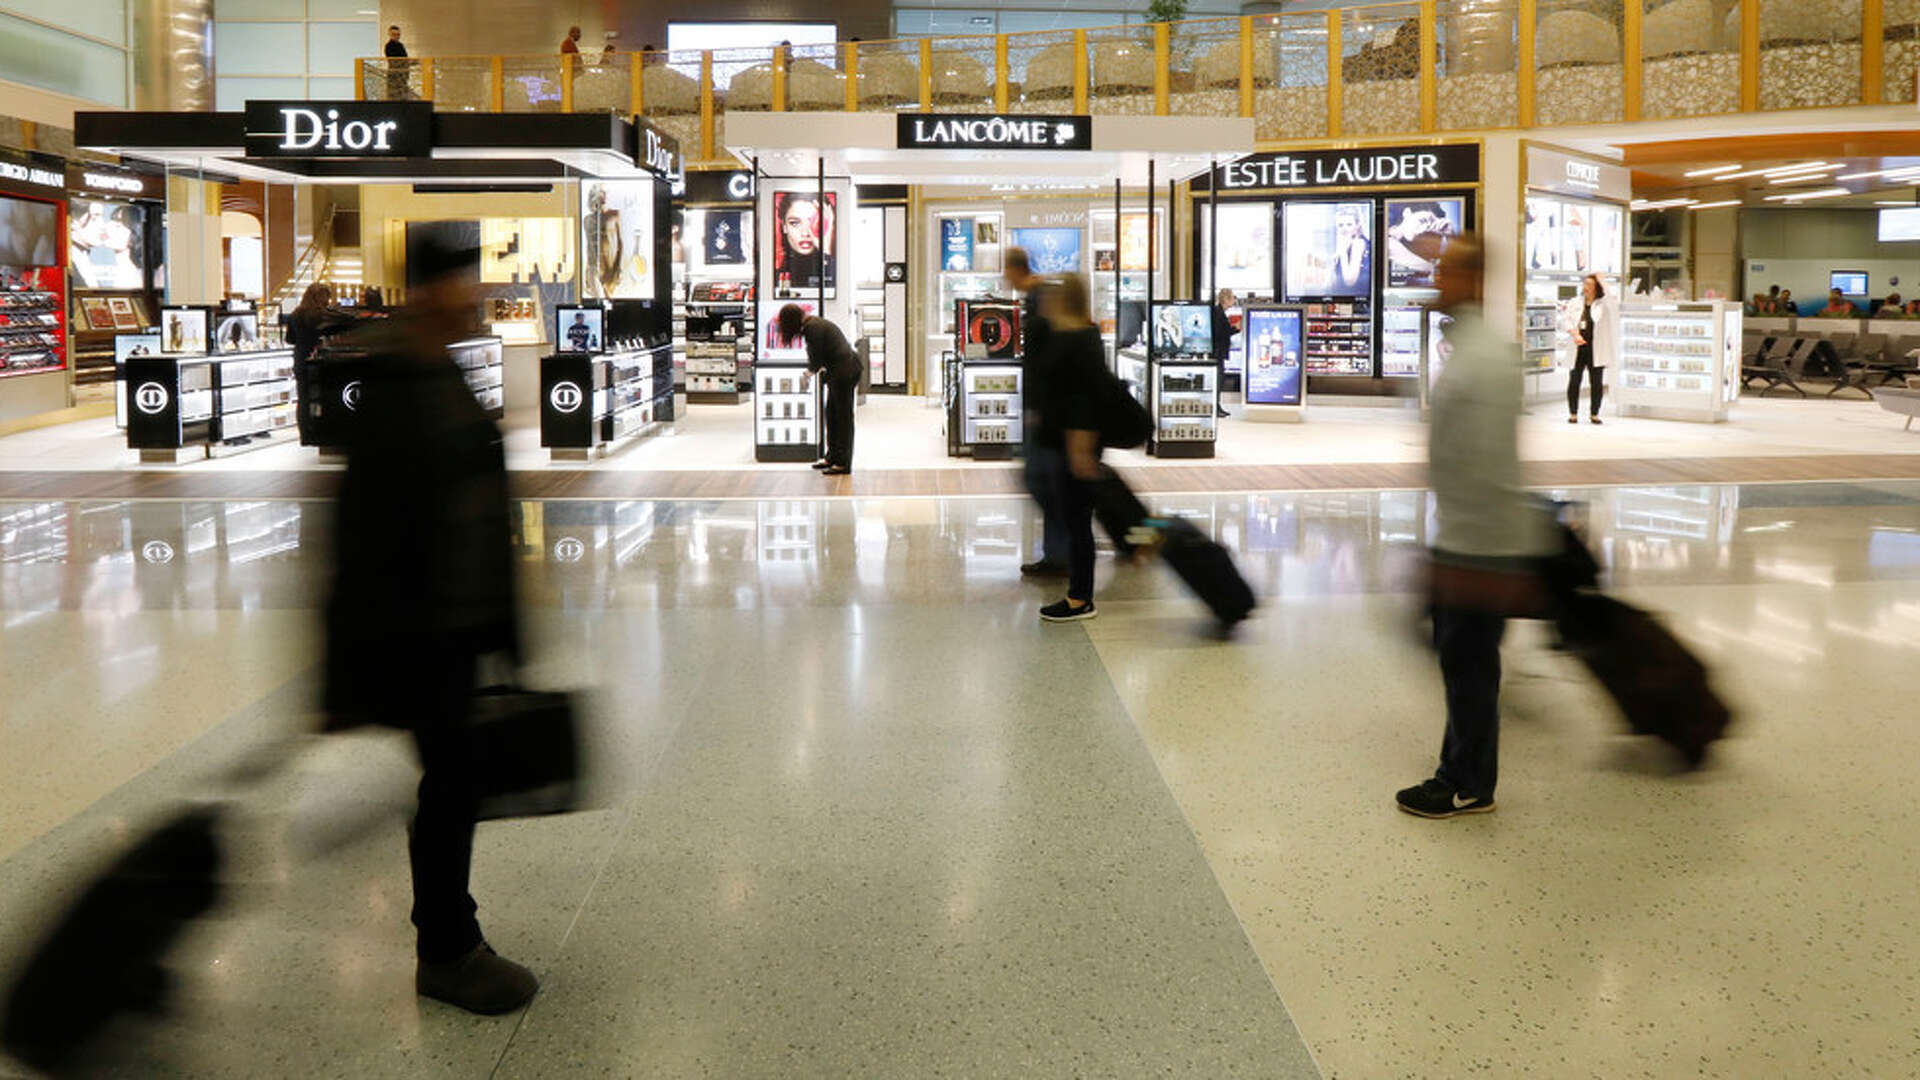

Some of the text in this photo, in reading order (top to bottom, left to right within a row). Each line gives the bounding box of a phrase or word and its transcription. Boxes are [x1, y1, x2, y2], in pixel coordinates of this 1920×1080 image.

[279, 109, 397, 149] Dior
[915, 117, 1047, 143] LANCÔME
[645, 129, 673, 175] Dior
[1316, 154, 1438, 183] LAUDER
